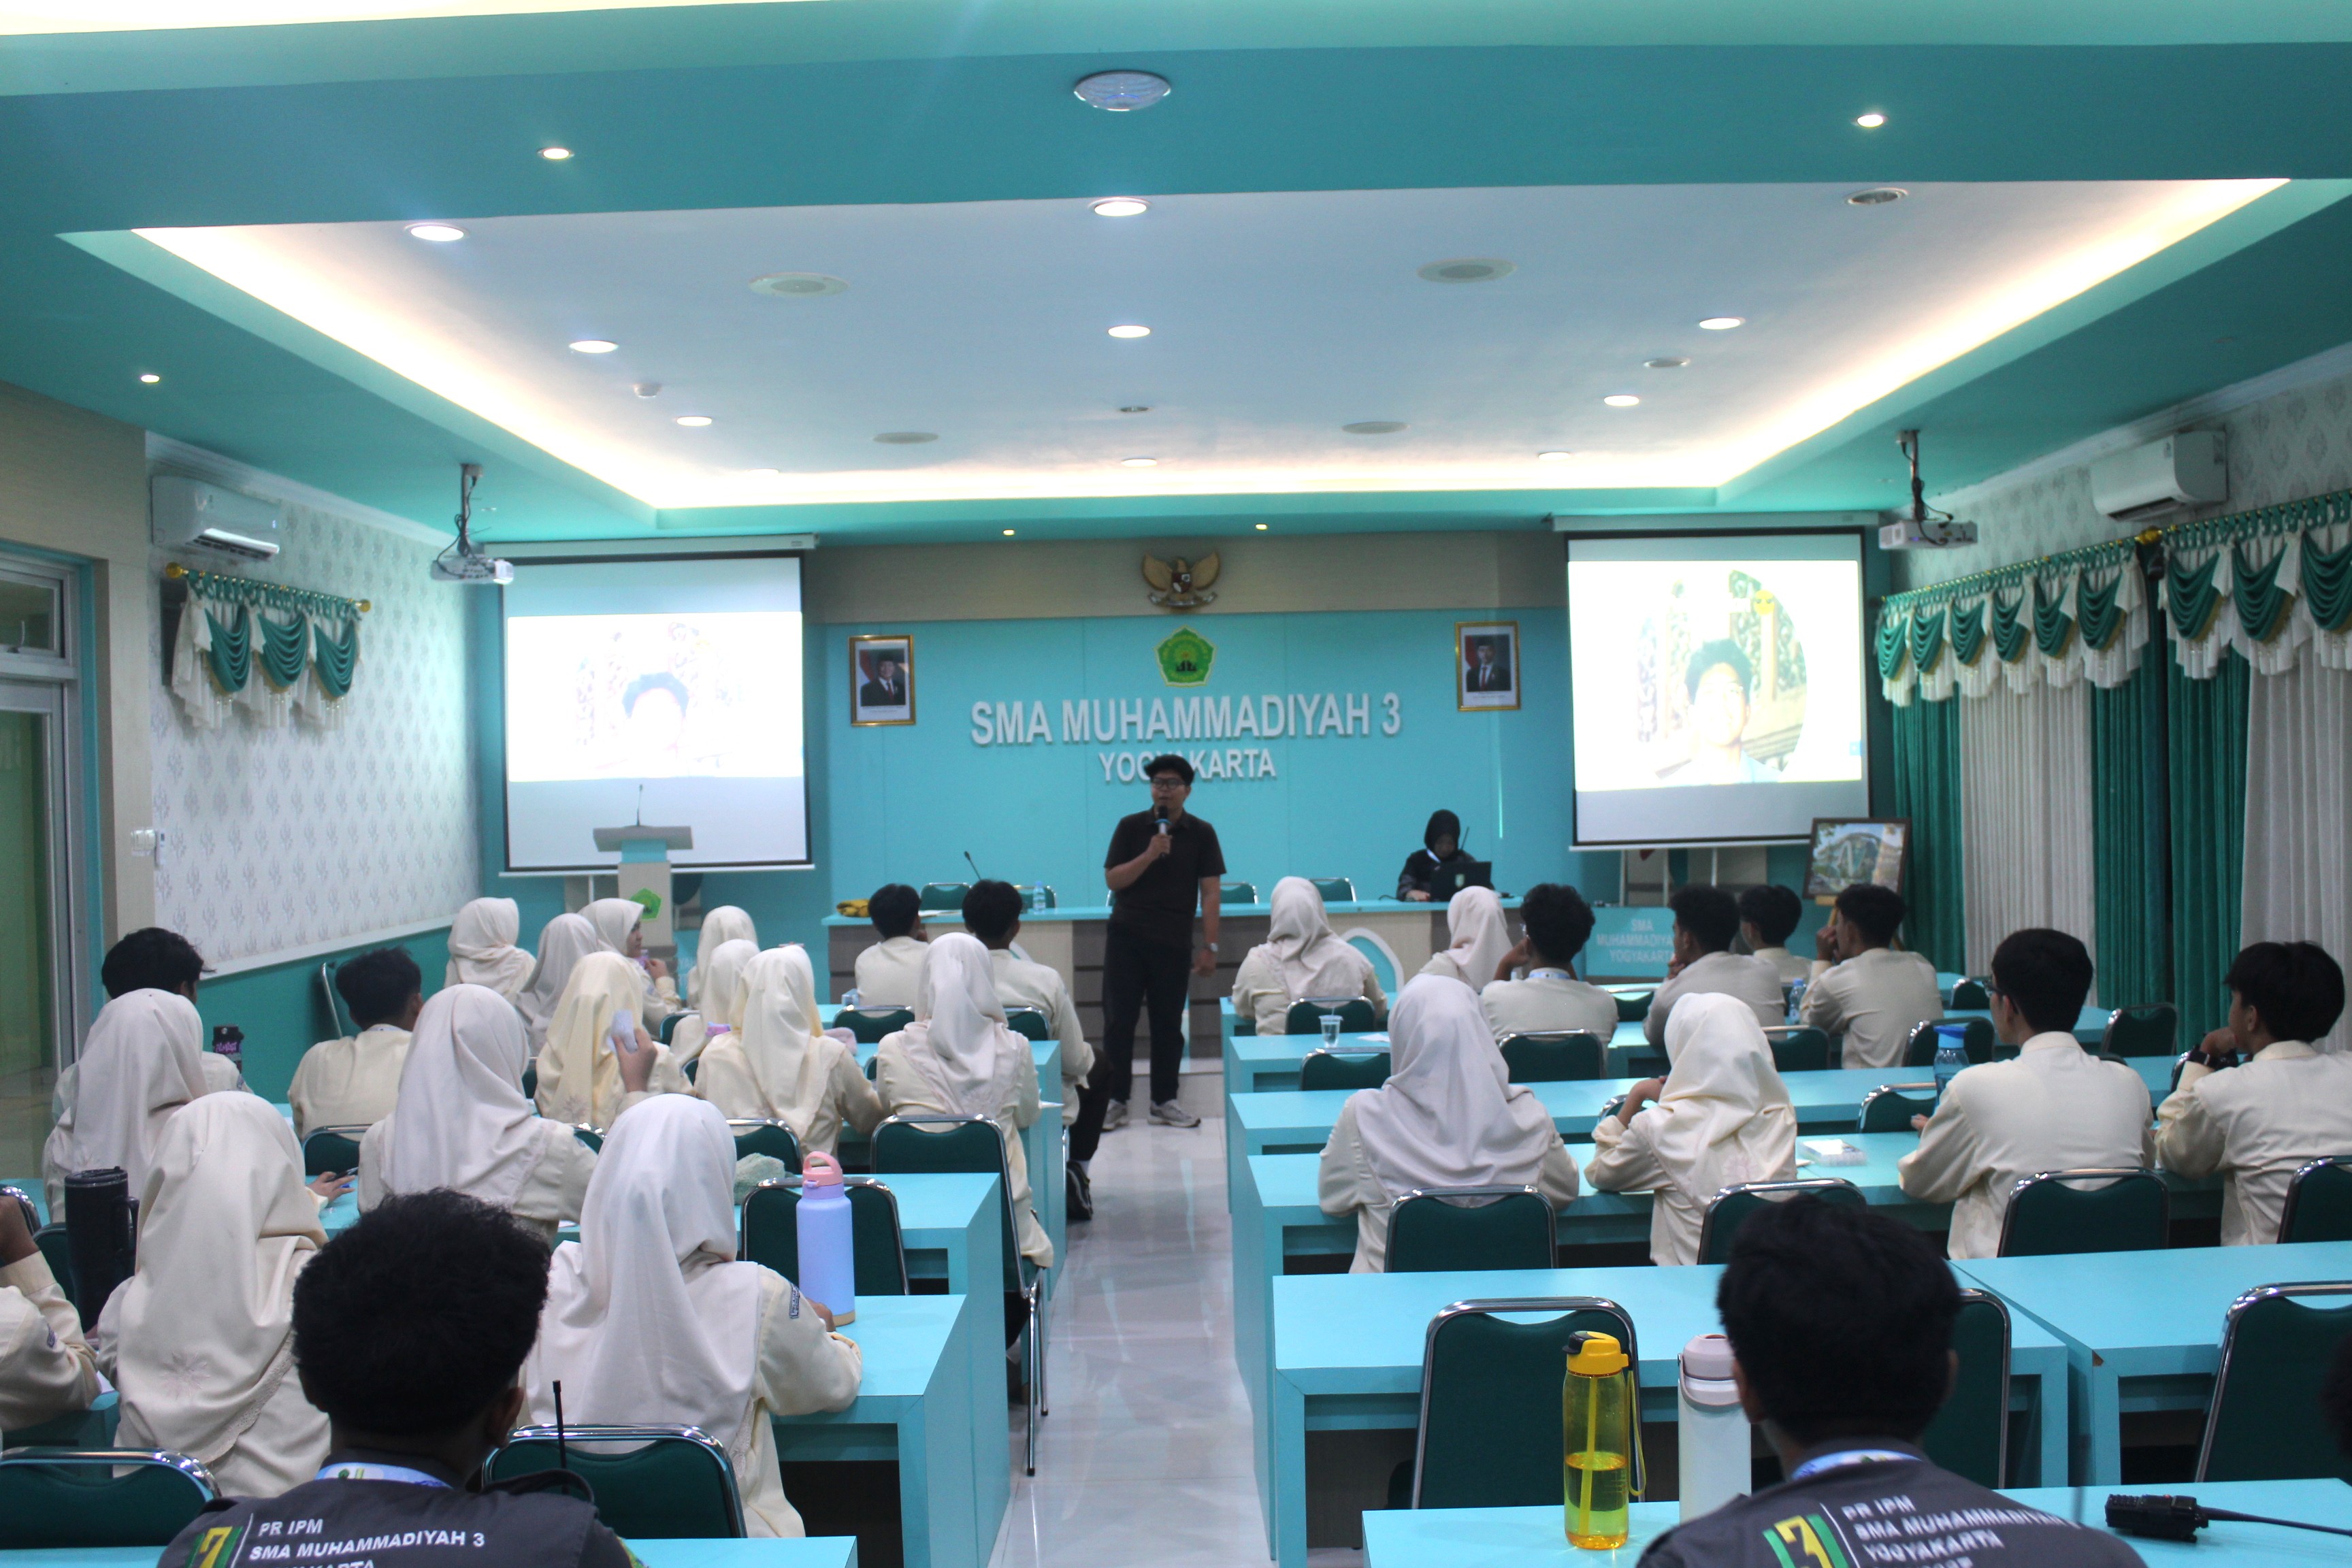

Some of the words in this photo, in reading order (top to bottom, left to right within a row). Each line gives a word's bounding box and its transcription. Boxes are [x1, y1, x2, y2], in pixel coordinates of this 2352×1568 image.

[971, 700, 1053, 745] SMA
[1062, 693, 1369, 744] MUHAMMADIYAH
[1381, 692, 1401, 736] 3
[1098, 748, 1277, 783] YOGKARTA
[1597, 934, 1674, 947] MUHAMMADIYA
[1841, 1502, 1874, 1521] PR
[258, 1521, 283, 1537] PR
[287, 1518, 323, 1535] IPM
[249, 1544, 291, 1561] SMA
[295, 1530, 466, 1557] MUHAMMADIYAH
[472, 1533, 485, 1547] 3
